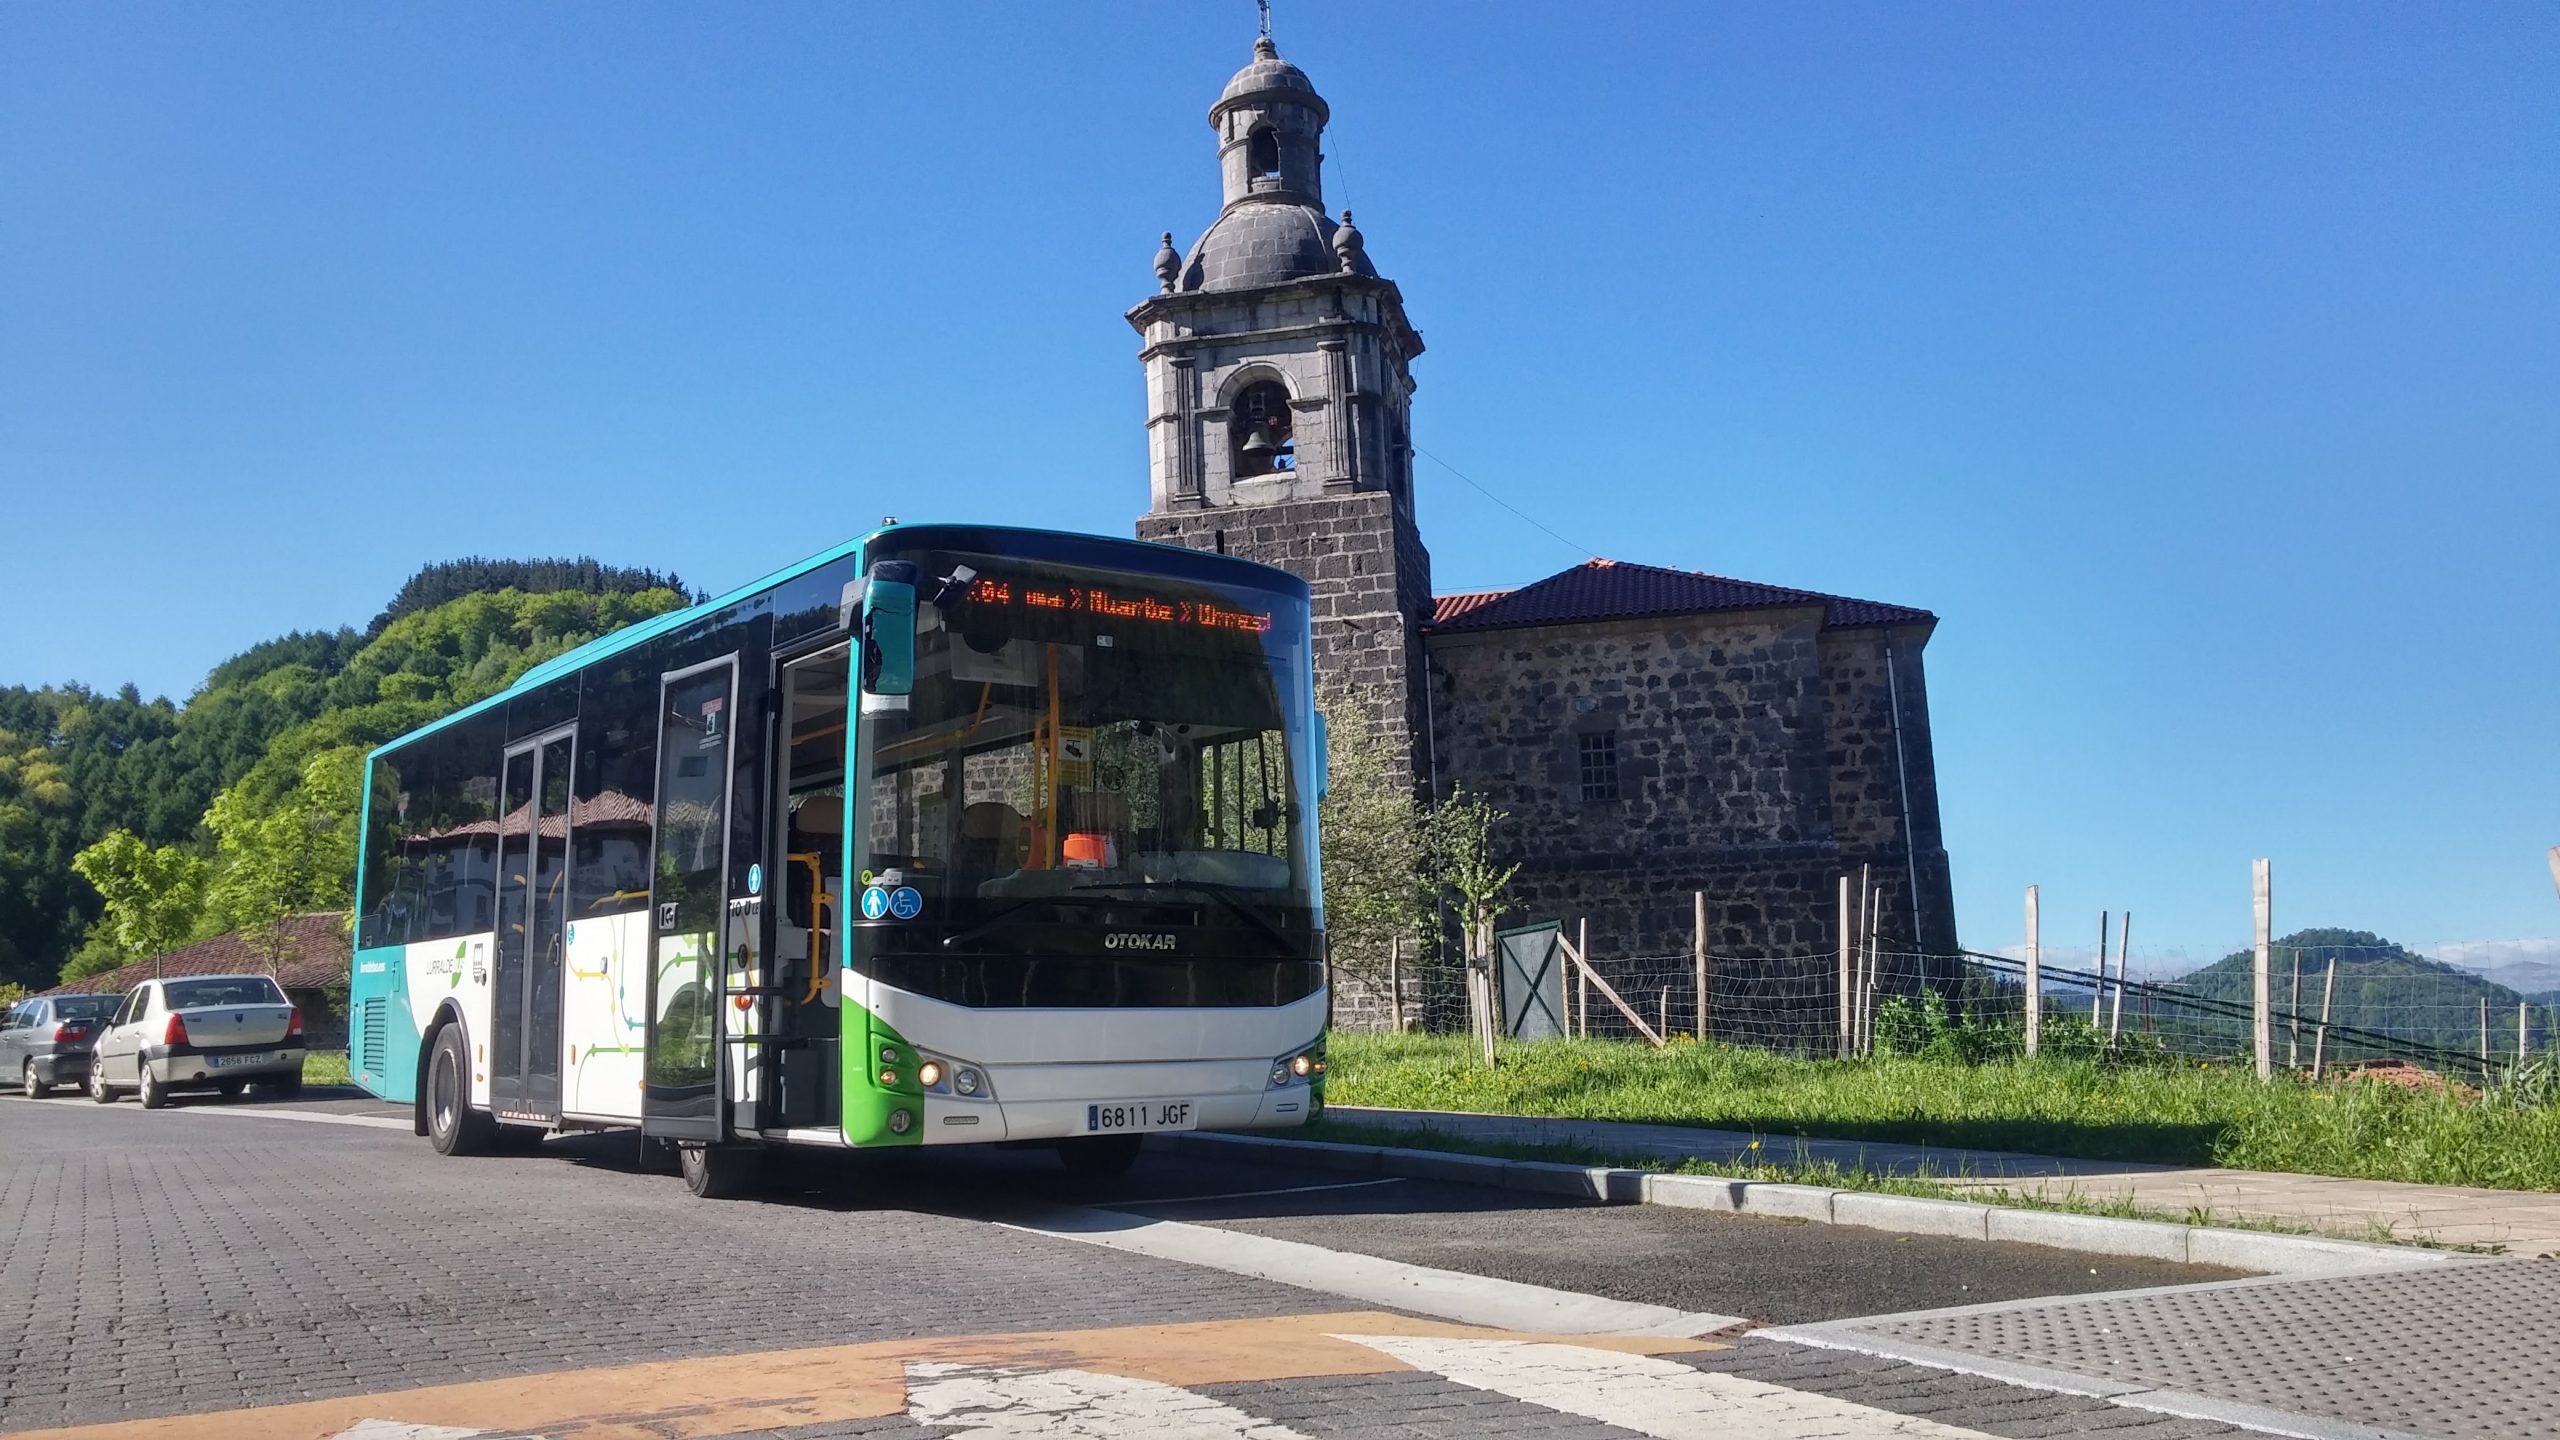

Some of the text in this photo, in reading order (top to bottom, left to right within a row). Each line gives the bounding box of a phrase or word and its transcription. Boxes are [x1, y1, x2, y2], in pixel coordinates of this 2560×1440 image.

[1104, 933, 1177, 950] OTOKAR
[1102, 1104, 1190, 1128] 6811 JGF
